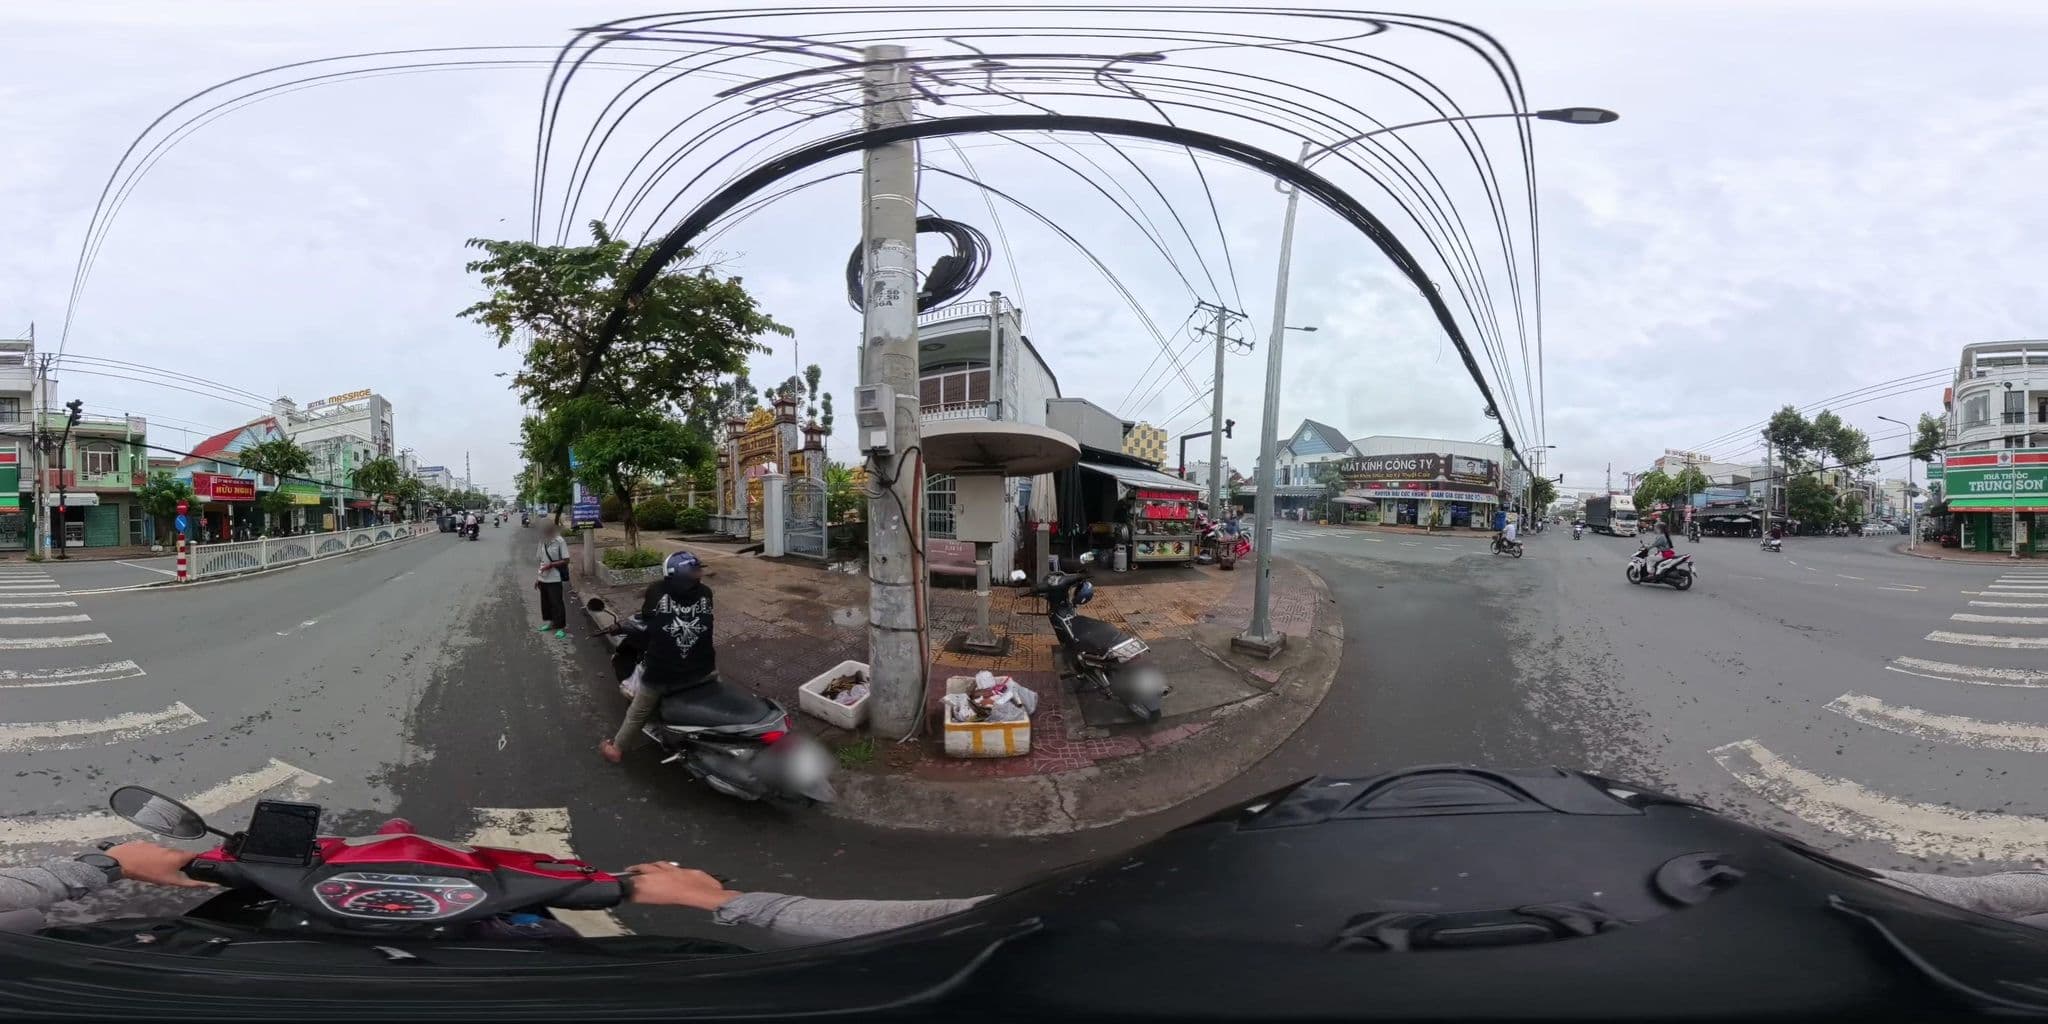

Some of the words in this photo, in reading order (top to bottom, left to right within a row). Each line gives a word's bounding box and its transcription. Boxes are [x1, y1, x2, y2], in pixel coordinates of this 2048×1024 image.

[328, 388, 371, 403] MASSAGE
[1361, 459, 1383, 471] KÍNH
[1385, 458, 1417, 470] CÔNG
[1419, 459, 1433, 469] TY
[1968, 480, 2012, 491] TRUNG
